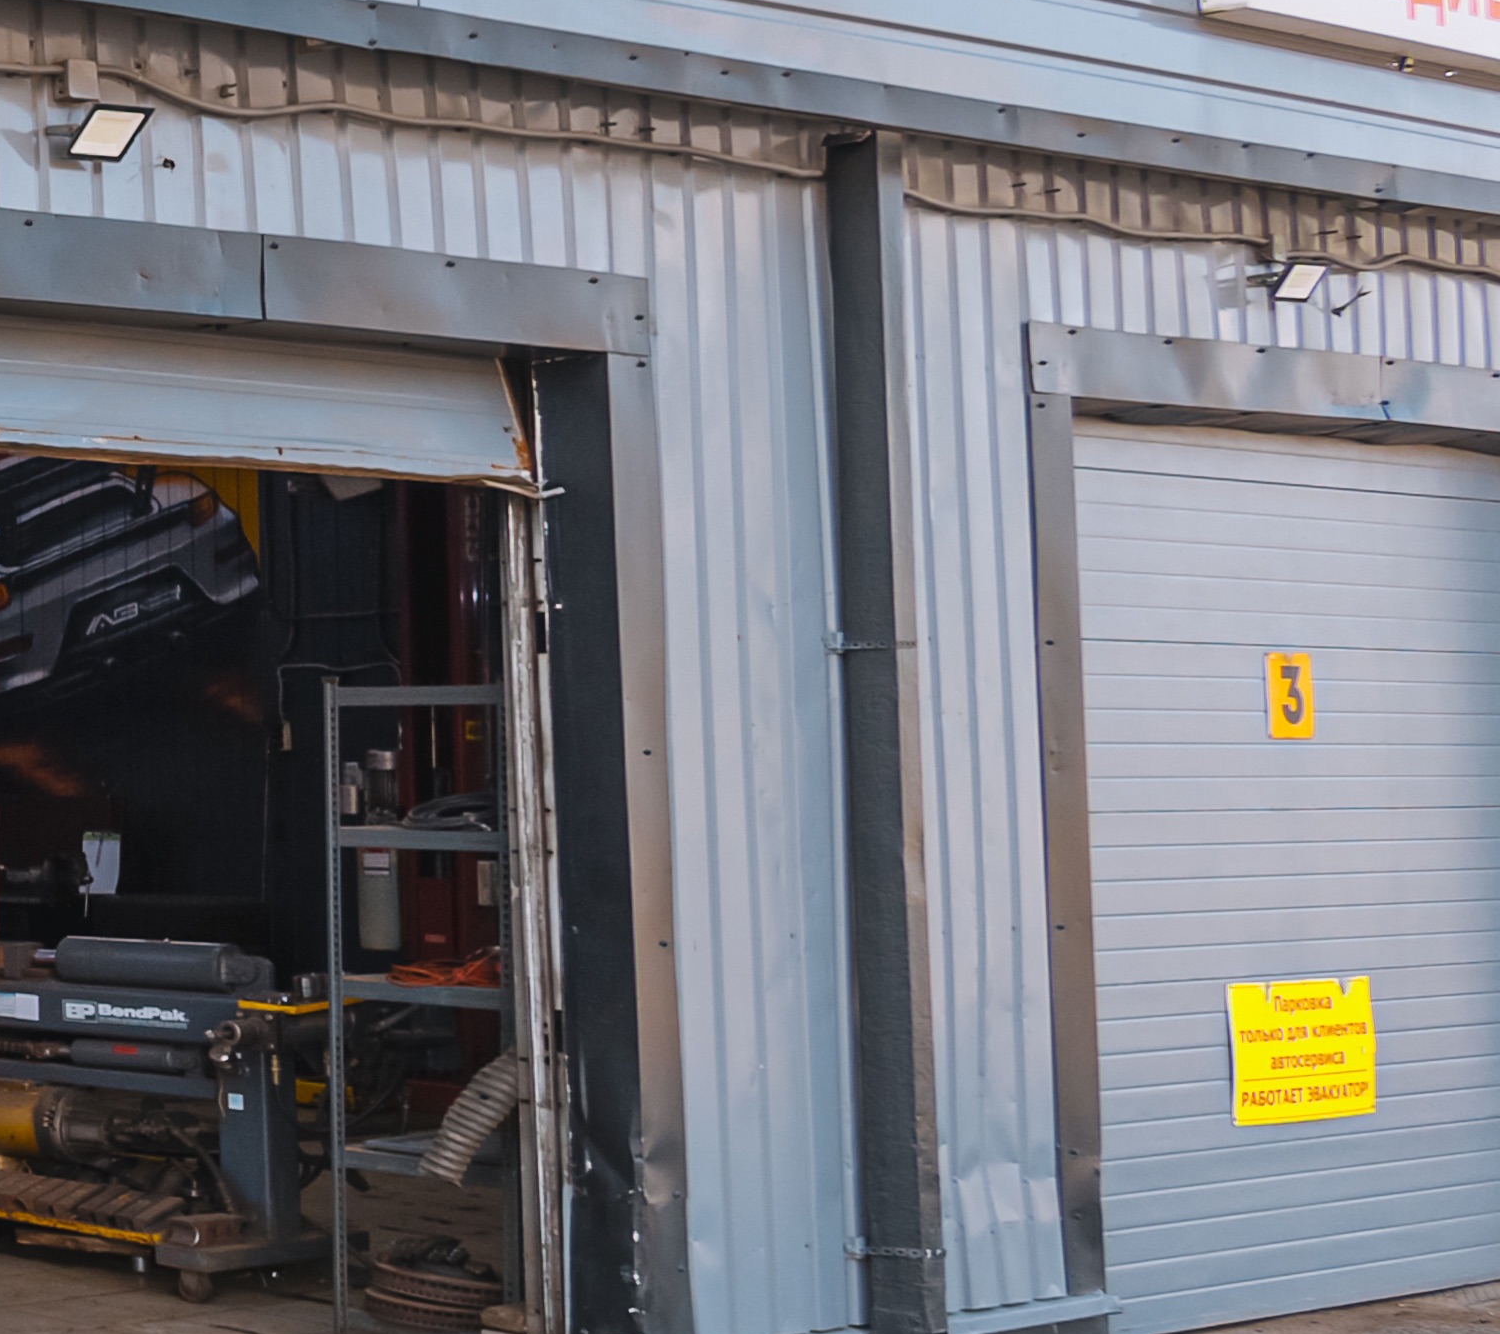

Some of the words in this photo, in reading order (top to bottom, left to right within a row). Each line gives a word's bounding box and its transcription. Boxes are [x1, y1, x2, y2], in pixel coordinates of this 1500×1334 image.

[1280, 665, 1305, 725] 3
[1274, 996, 1332, 1015] Парковка
[1239, 1028, 1284, 1043] только
[1287, 1026, 1308, 1042] для
[1312, 1022, 1368, 1037] клиентов
[1271, 1051, 1346, 1069] автосервиса
[1241, 1087, 1303, 1107] РАБОТАЕТ
